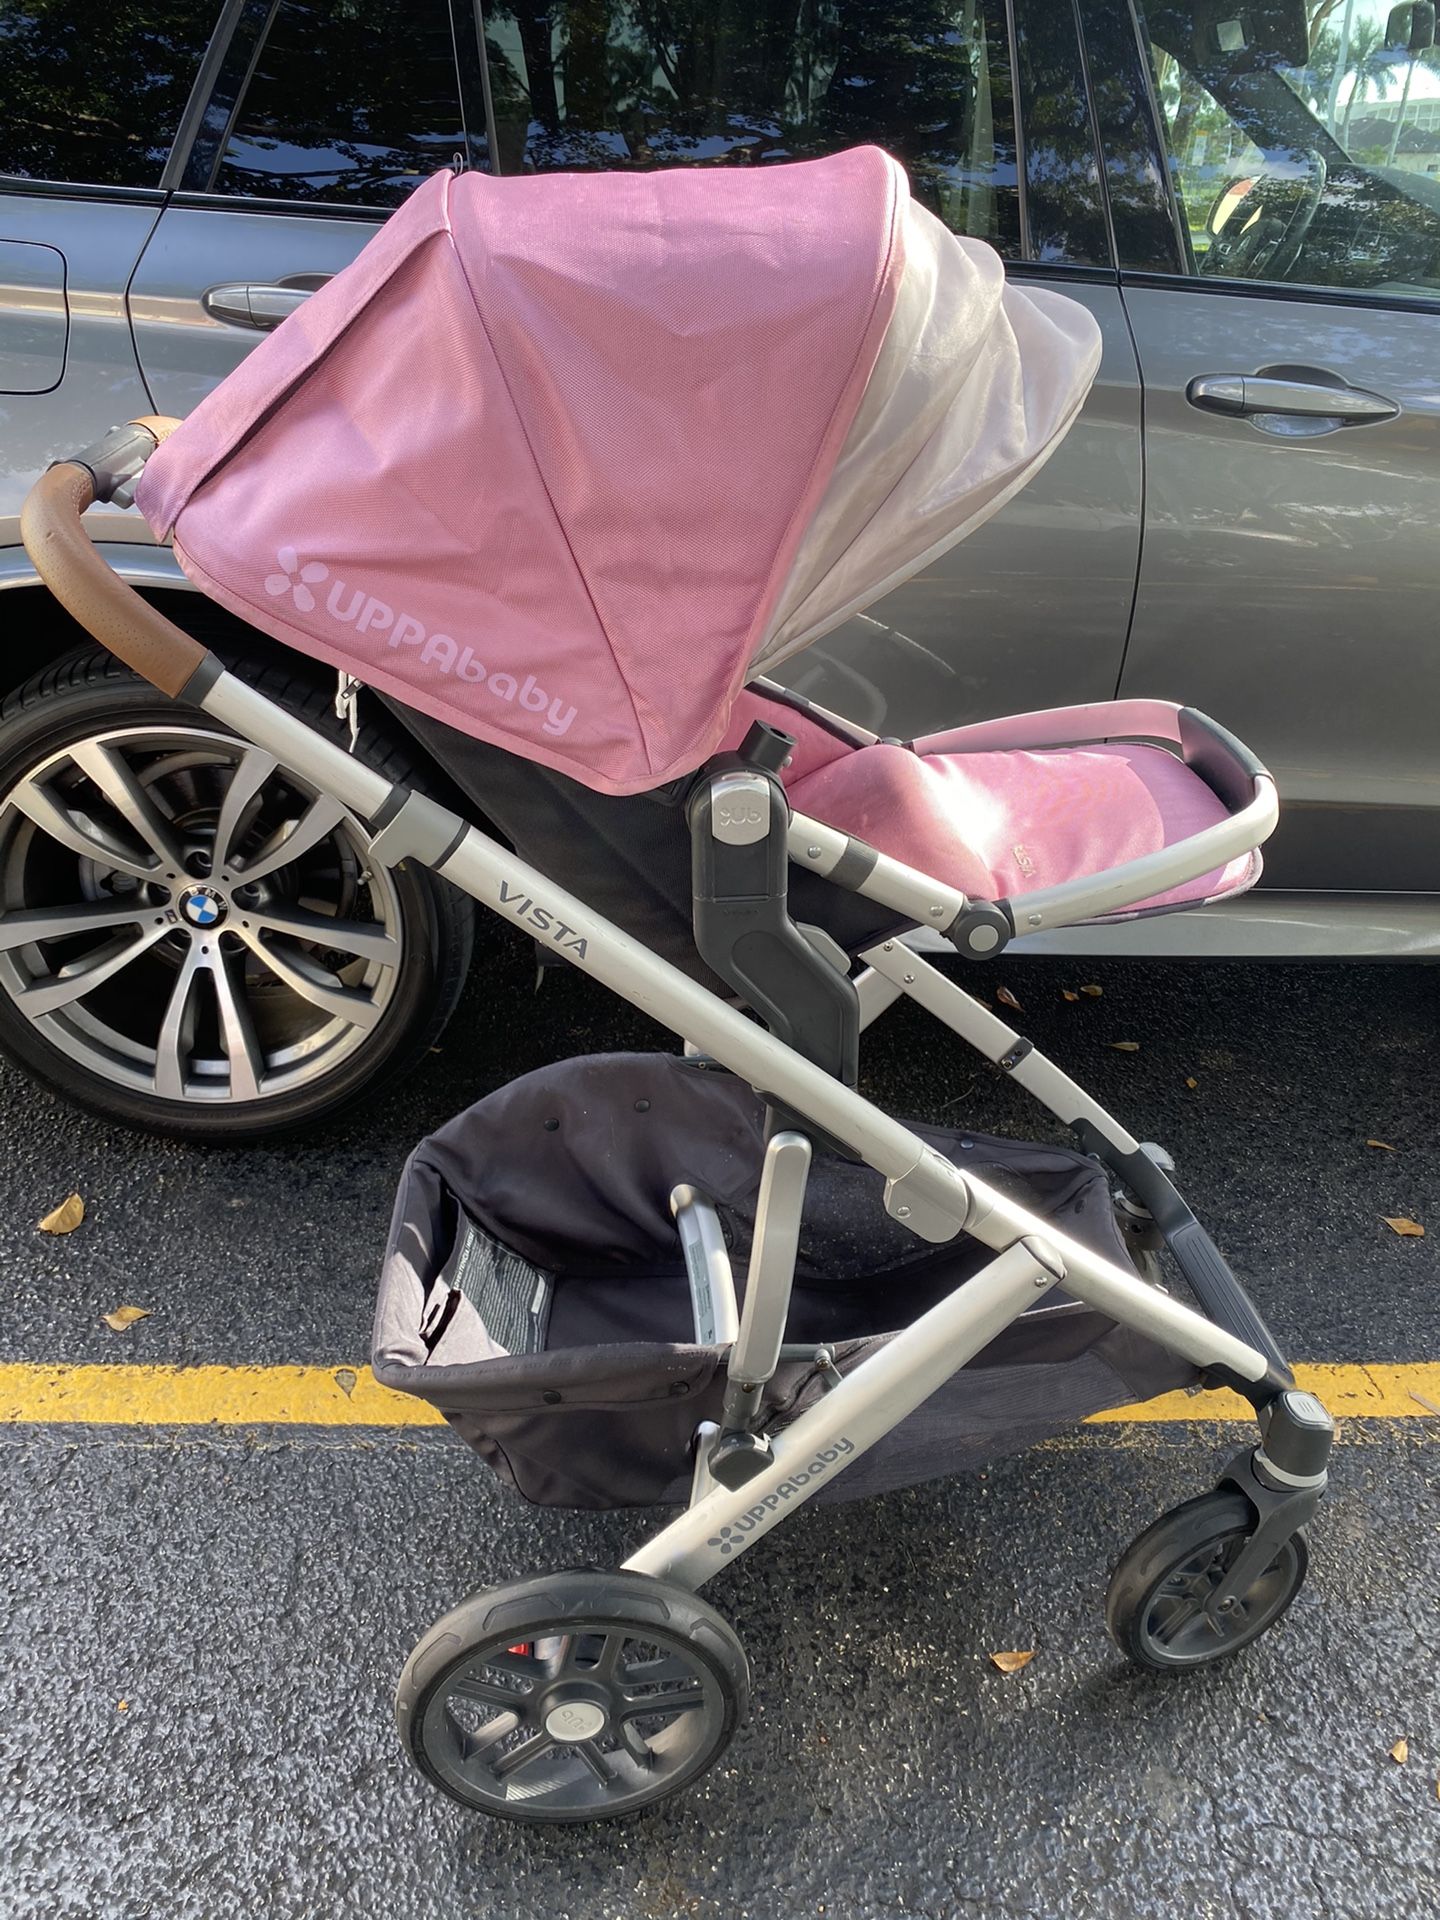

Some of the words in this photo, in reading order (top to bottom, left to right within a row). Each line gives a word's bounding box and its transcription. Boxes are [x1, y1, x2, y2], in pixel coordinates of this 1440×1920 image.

[327, 580, 578, 736] UPPAbaby
[500, 880, 588, 960] VISTA
[734, 1437, 855, 1532] UPPAbaby
